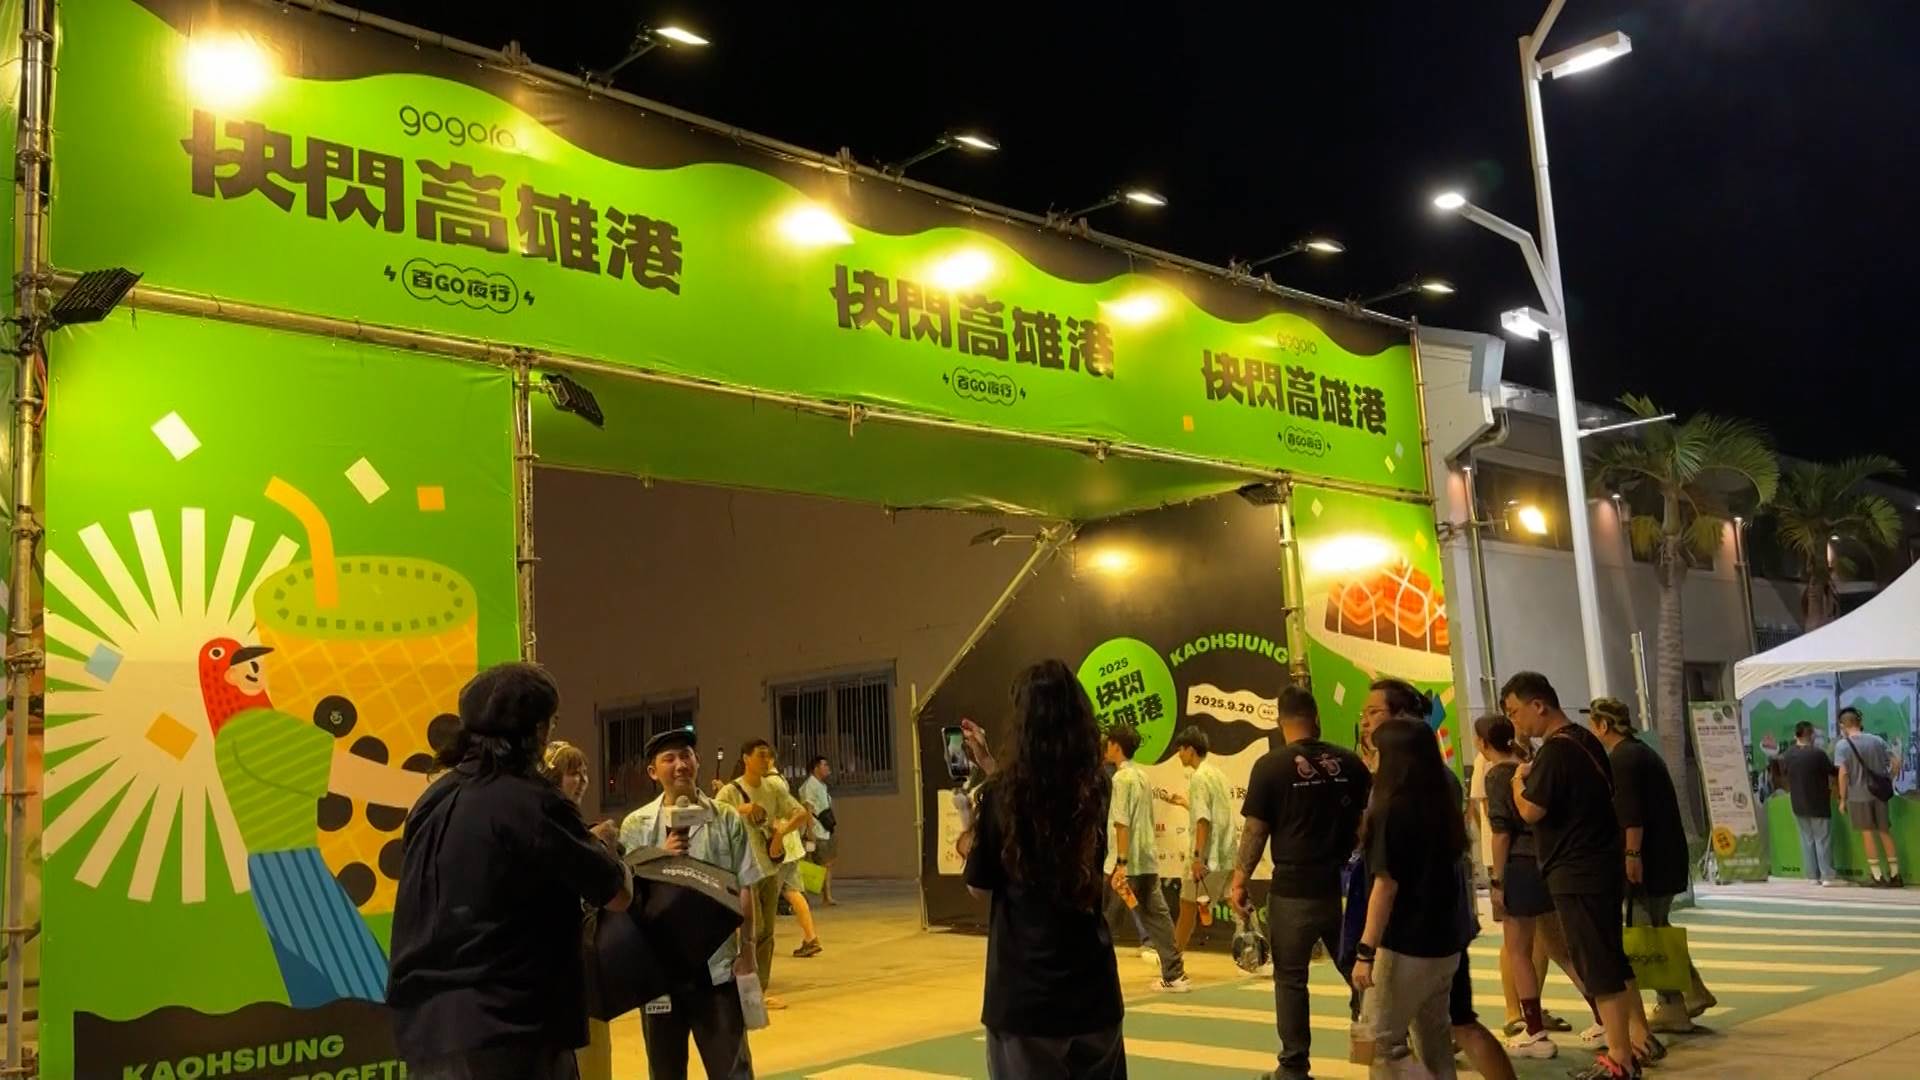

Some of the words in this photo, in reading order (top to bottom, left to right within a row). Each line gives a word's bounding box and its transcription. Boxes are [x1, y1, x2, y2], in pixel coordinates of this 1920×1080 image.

[400, 105, 516, 146] gogoro
[180, 109, 683, 295] 快閃高雄港
[412, 269, 510, 302] 百GO夜行
[829, 264, 1114, 379] 快閃高雄港
[1201, 350, 1386, 435] 快閃高雄港
[1099, 658, 1128, 677] 2025
[1169, 633, 1288, 667] KAOHSIUNG
[1096, 670, 1144, 709] 快閃
[1194, 695, 1254, 714] 2025.9.20
[122, 1034, 344, 1080] KAOHSIUNG
